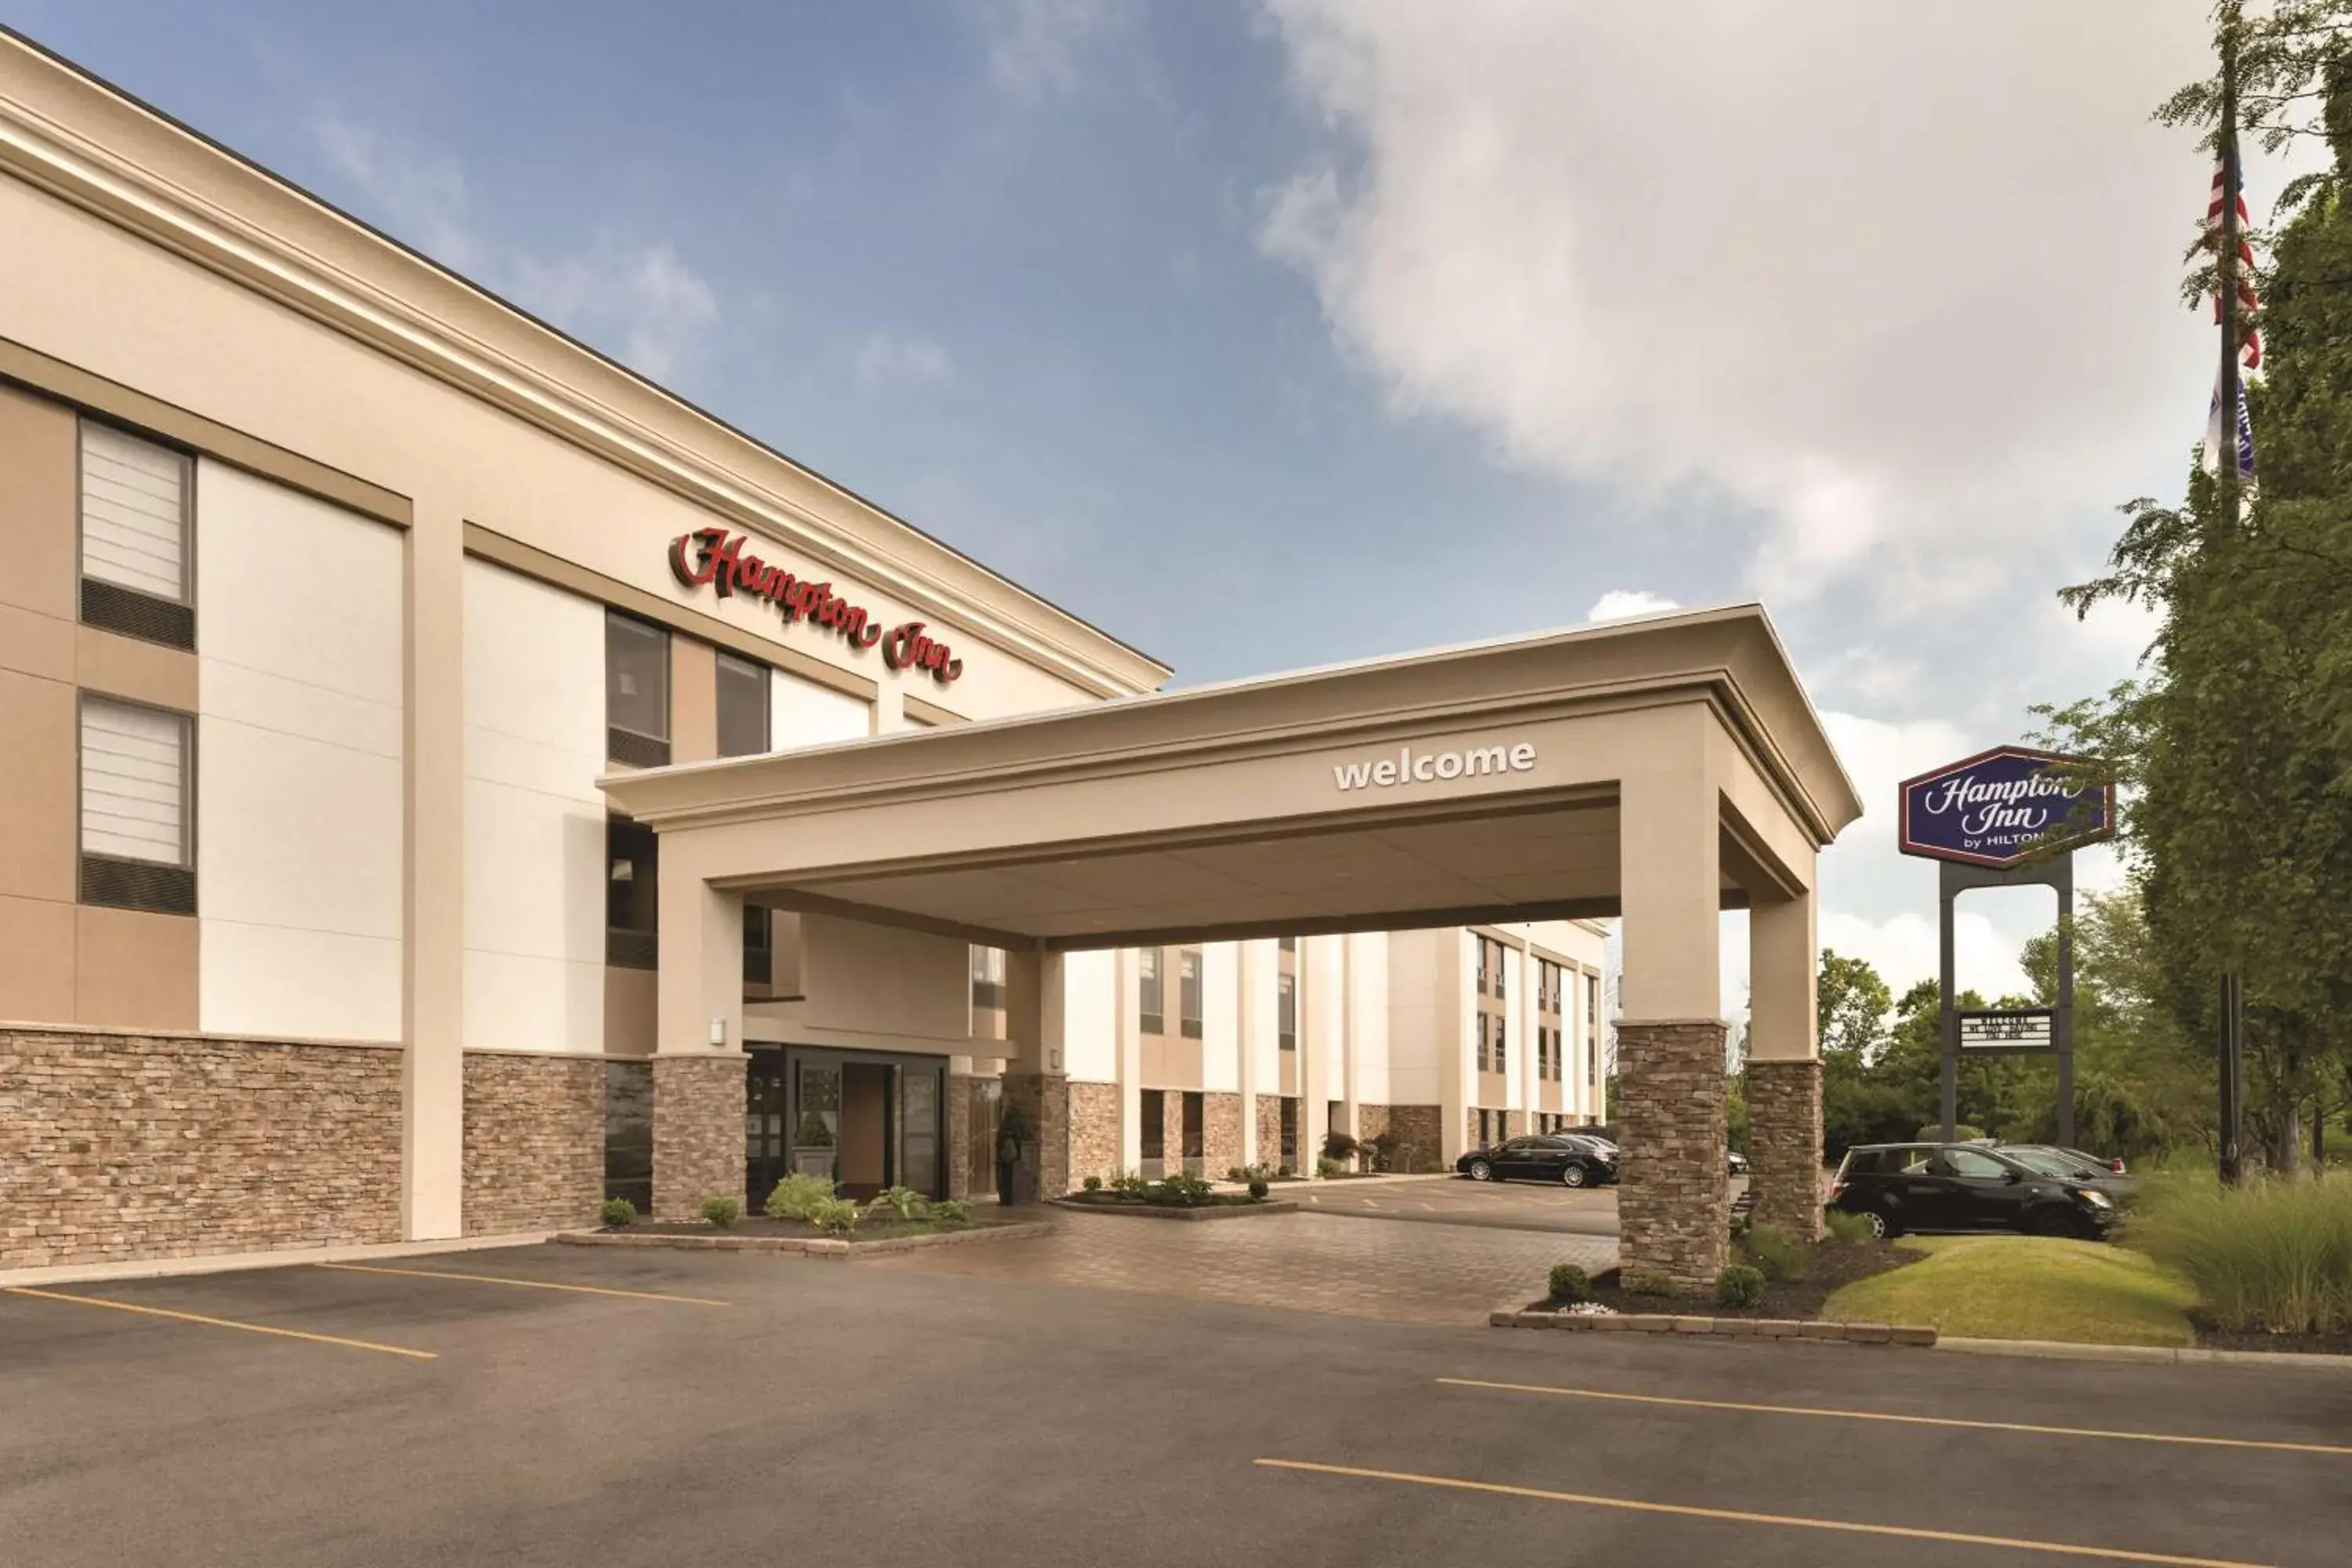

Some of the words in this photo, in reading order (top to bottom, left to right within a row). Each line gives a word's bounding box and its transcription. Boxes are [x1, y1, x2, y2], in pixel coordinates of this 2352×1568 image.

[669, 527, 882, 648] Hampton
[882, 622, 964, 682] Inn
[1333, 742, 1537, 790] welcome
[1925, 773, 2085, 815] Hampton
[1962, 802, 2047, 835] Inn
[1964, 839, 1981, 850] by
